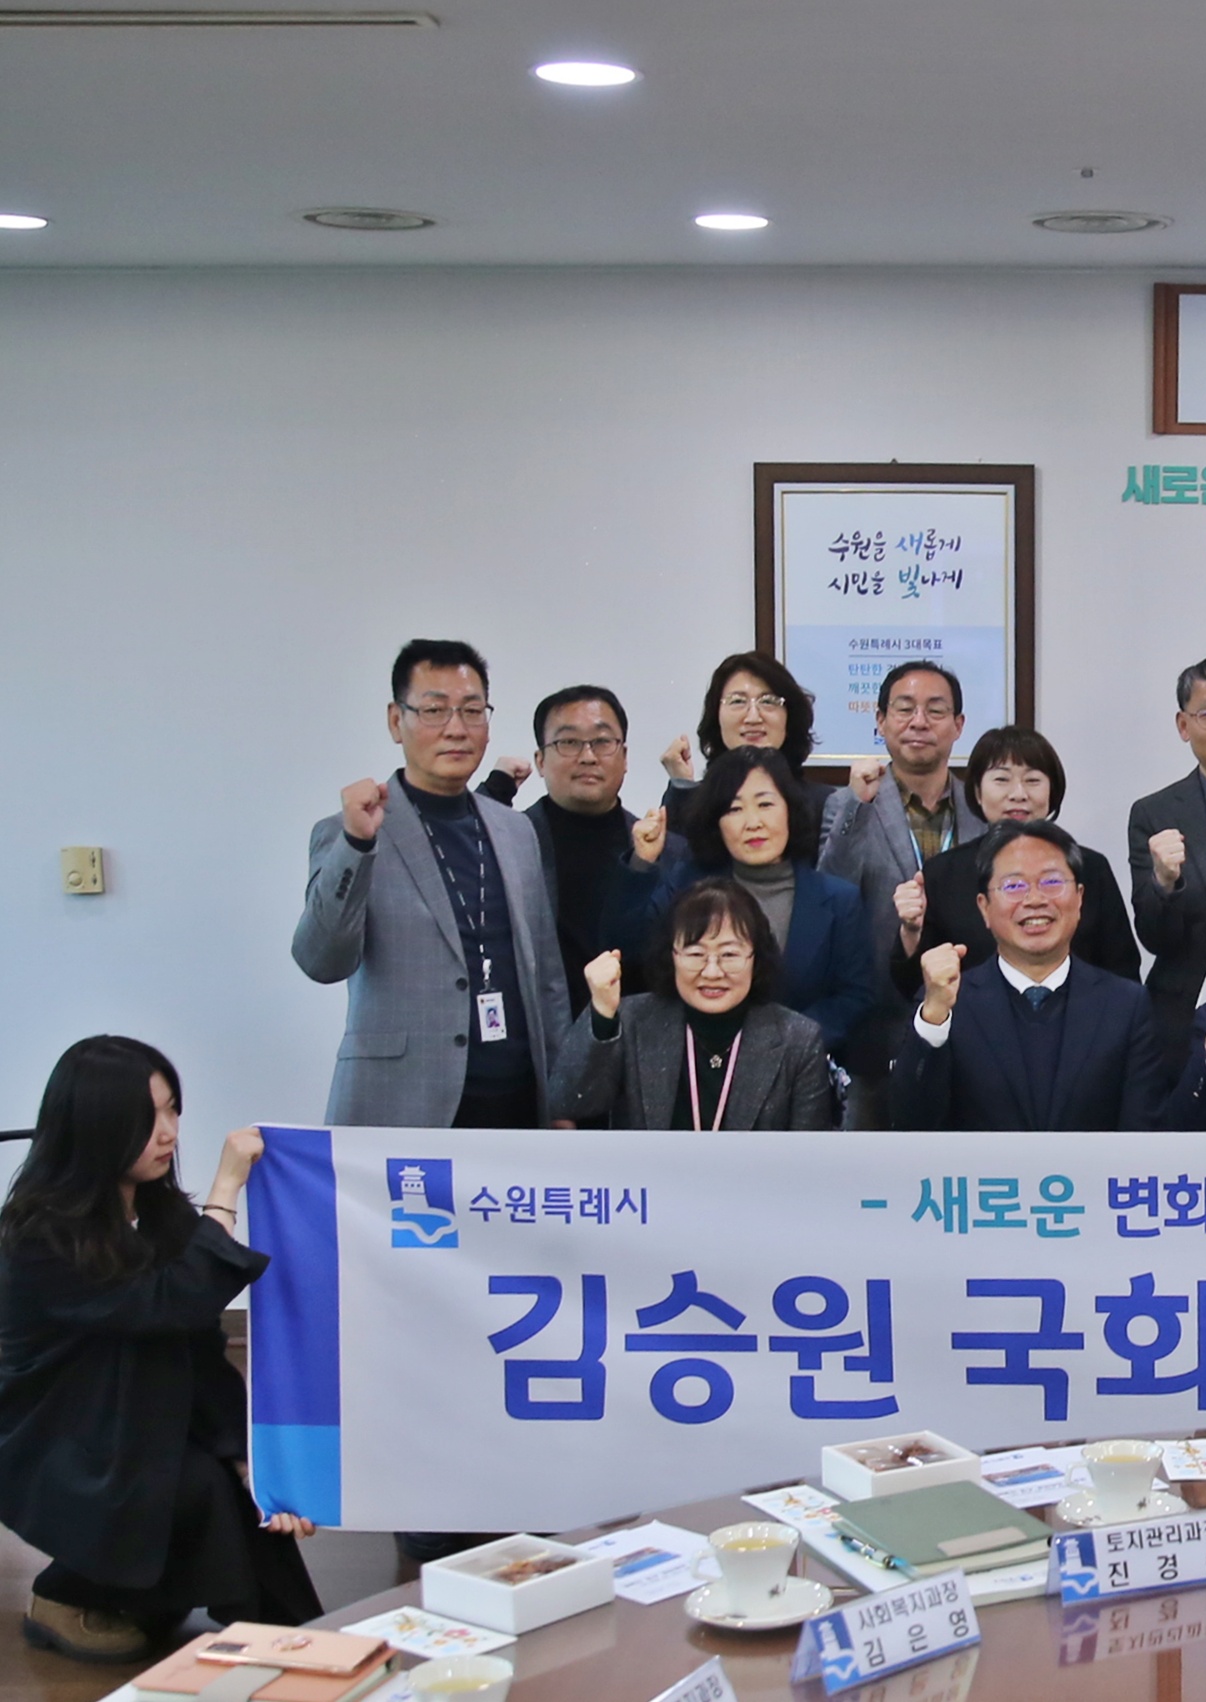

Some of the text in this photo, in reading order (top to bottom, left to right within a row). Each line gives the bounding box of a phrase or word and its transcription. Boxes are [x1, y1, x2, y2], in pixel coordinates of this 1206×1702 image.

[828, 528, 962, 562] 수원을 새롭게
[828, 564, 963, 599] 시민을 빛나게
[848, 638, 942, 651] 수원특례시 3대목표
[848, 663, 882, 677] 탄탄한
[469, 1183, 648, 1226] 수원특례시
[911, 1174, 1086, 1238] 새로운
[487, 1270, 900, 1425] 김승원
[858, 1579, 959, 1631] 사회복지과장
